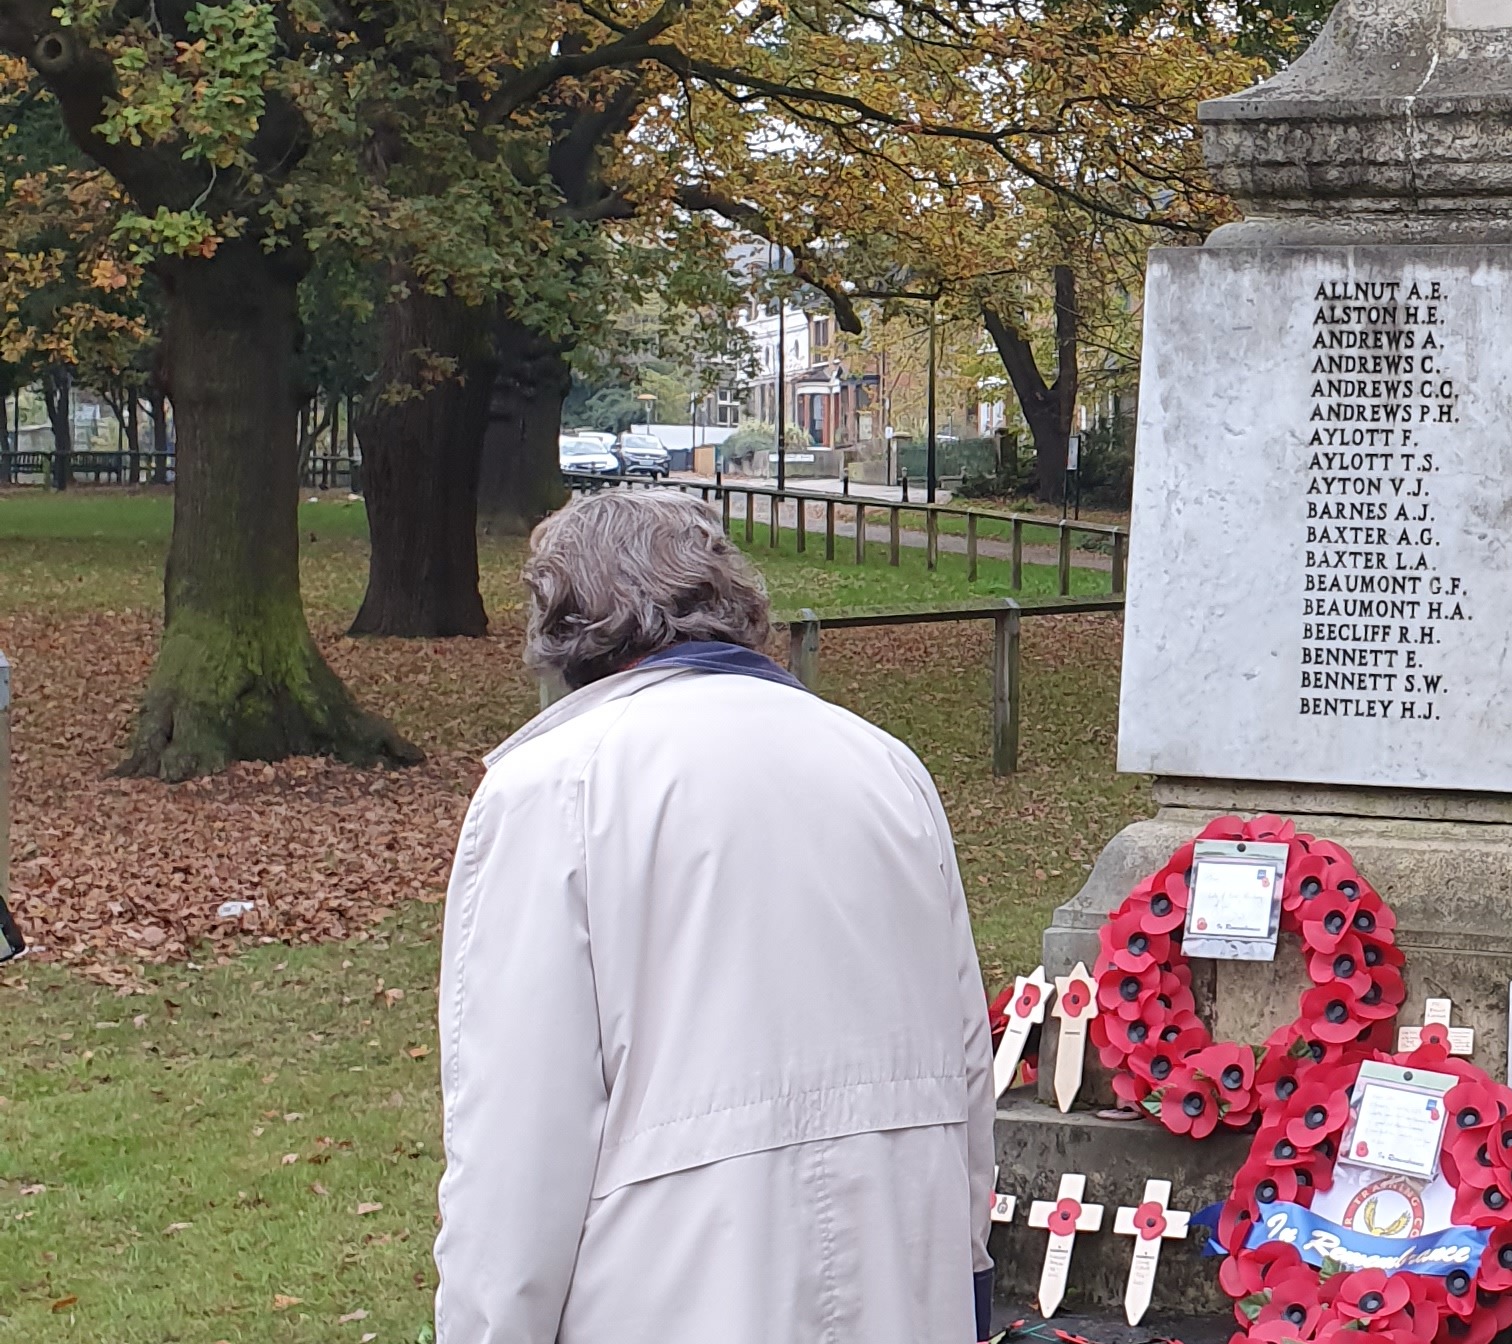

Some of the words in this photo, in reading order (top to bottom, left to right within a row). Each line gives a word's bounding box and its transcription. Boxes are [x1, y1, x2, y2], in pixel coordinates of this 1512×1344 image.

[1313, 280, 1401, 303] ALLNUT
[1406, 281, 1449, 302] A.E.
[1312, 307, 1398, 328] ALSTON
[1403, 305, 1445, 326] H.E.
[1310, 357, 1414, 376] ANDREWS
[1420, 354, 1441, 375] C.
[1309, 406, 1413, 426] ANDREWS
[1418, 406, 1460, 424] P.H.
[1307, 451, 1394, 472] AYLOTT
[1400, 453, 1440, 473] T.S.
[1305, 476, 1383, 497] AYTON
[1392, 476, 1430, 498] V.J.
[1306, 500, 1388, 521] BARNES
[1393, 502, 1435, 522] A.J.
[1305, 525, 1390, 546] BAXTER
[1395, 526, 1440, 547] A.G.
[1303, 573, 1422, 595] BEAUMONT
[1429, 576, 1468, 597] G.F.
[1302, 597, 1421, 620] BEAUMONT
[1426, 601, 1473, 621] H.A.
[1302, 622, 1392, 643] BEECLIFF
[1397, 625, 1441, 645] R.H.
[1300, 646, 1399, 669] BENNETT
[1404, 649, 1423, 669] E.
[1300, 670, 1398, 692] BENNETT
[1404, 674, 1448, 695] S.W.
[1298, 697, 1394, 719] BENTLEY
[1399, 700, 1441, 721] H.J.
[1266, 1212, 1298, 1244] In
